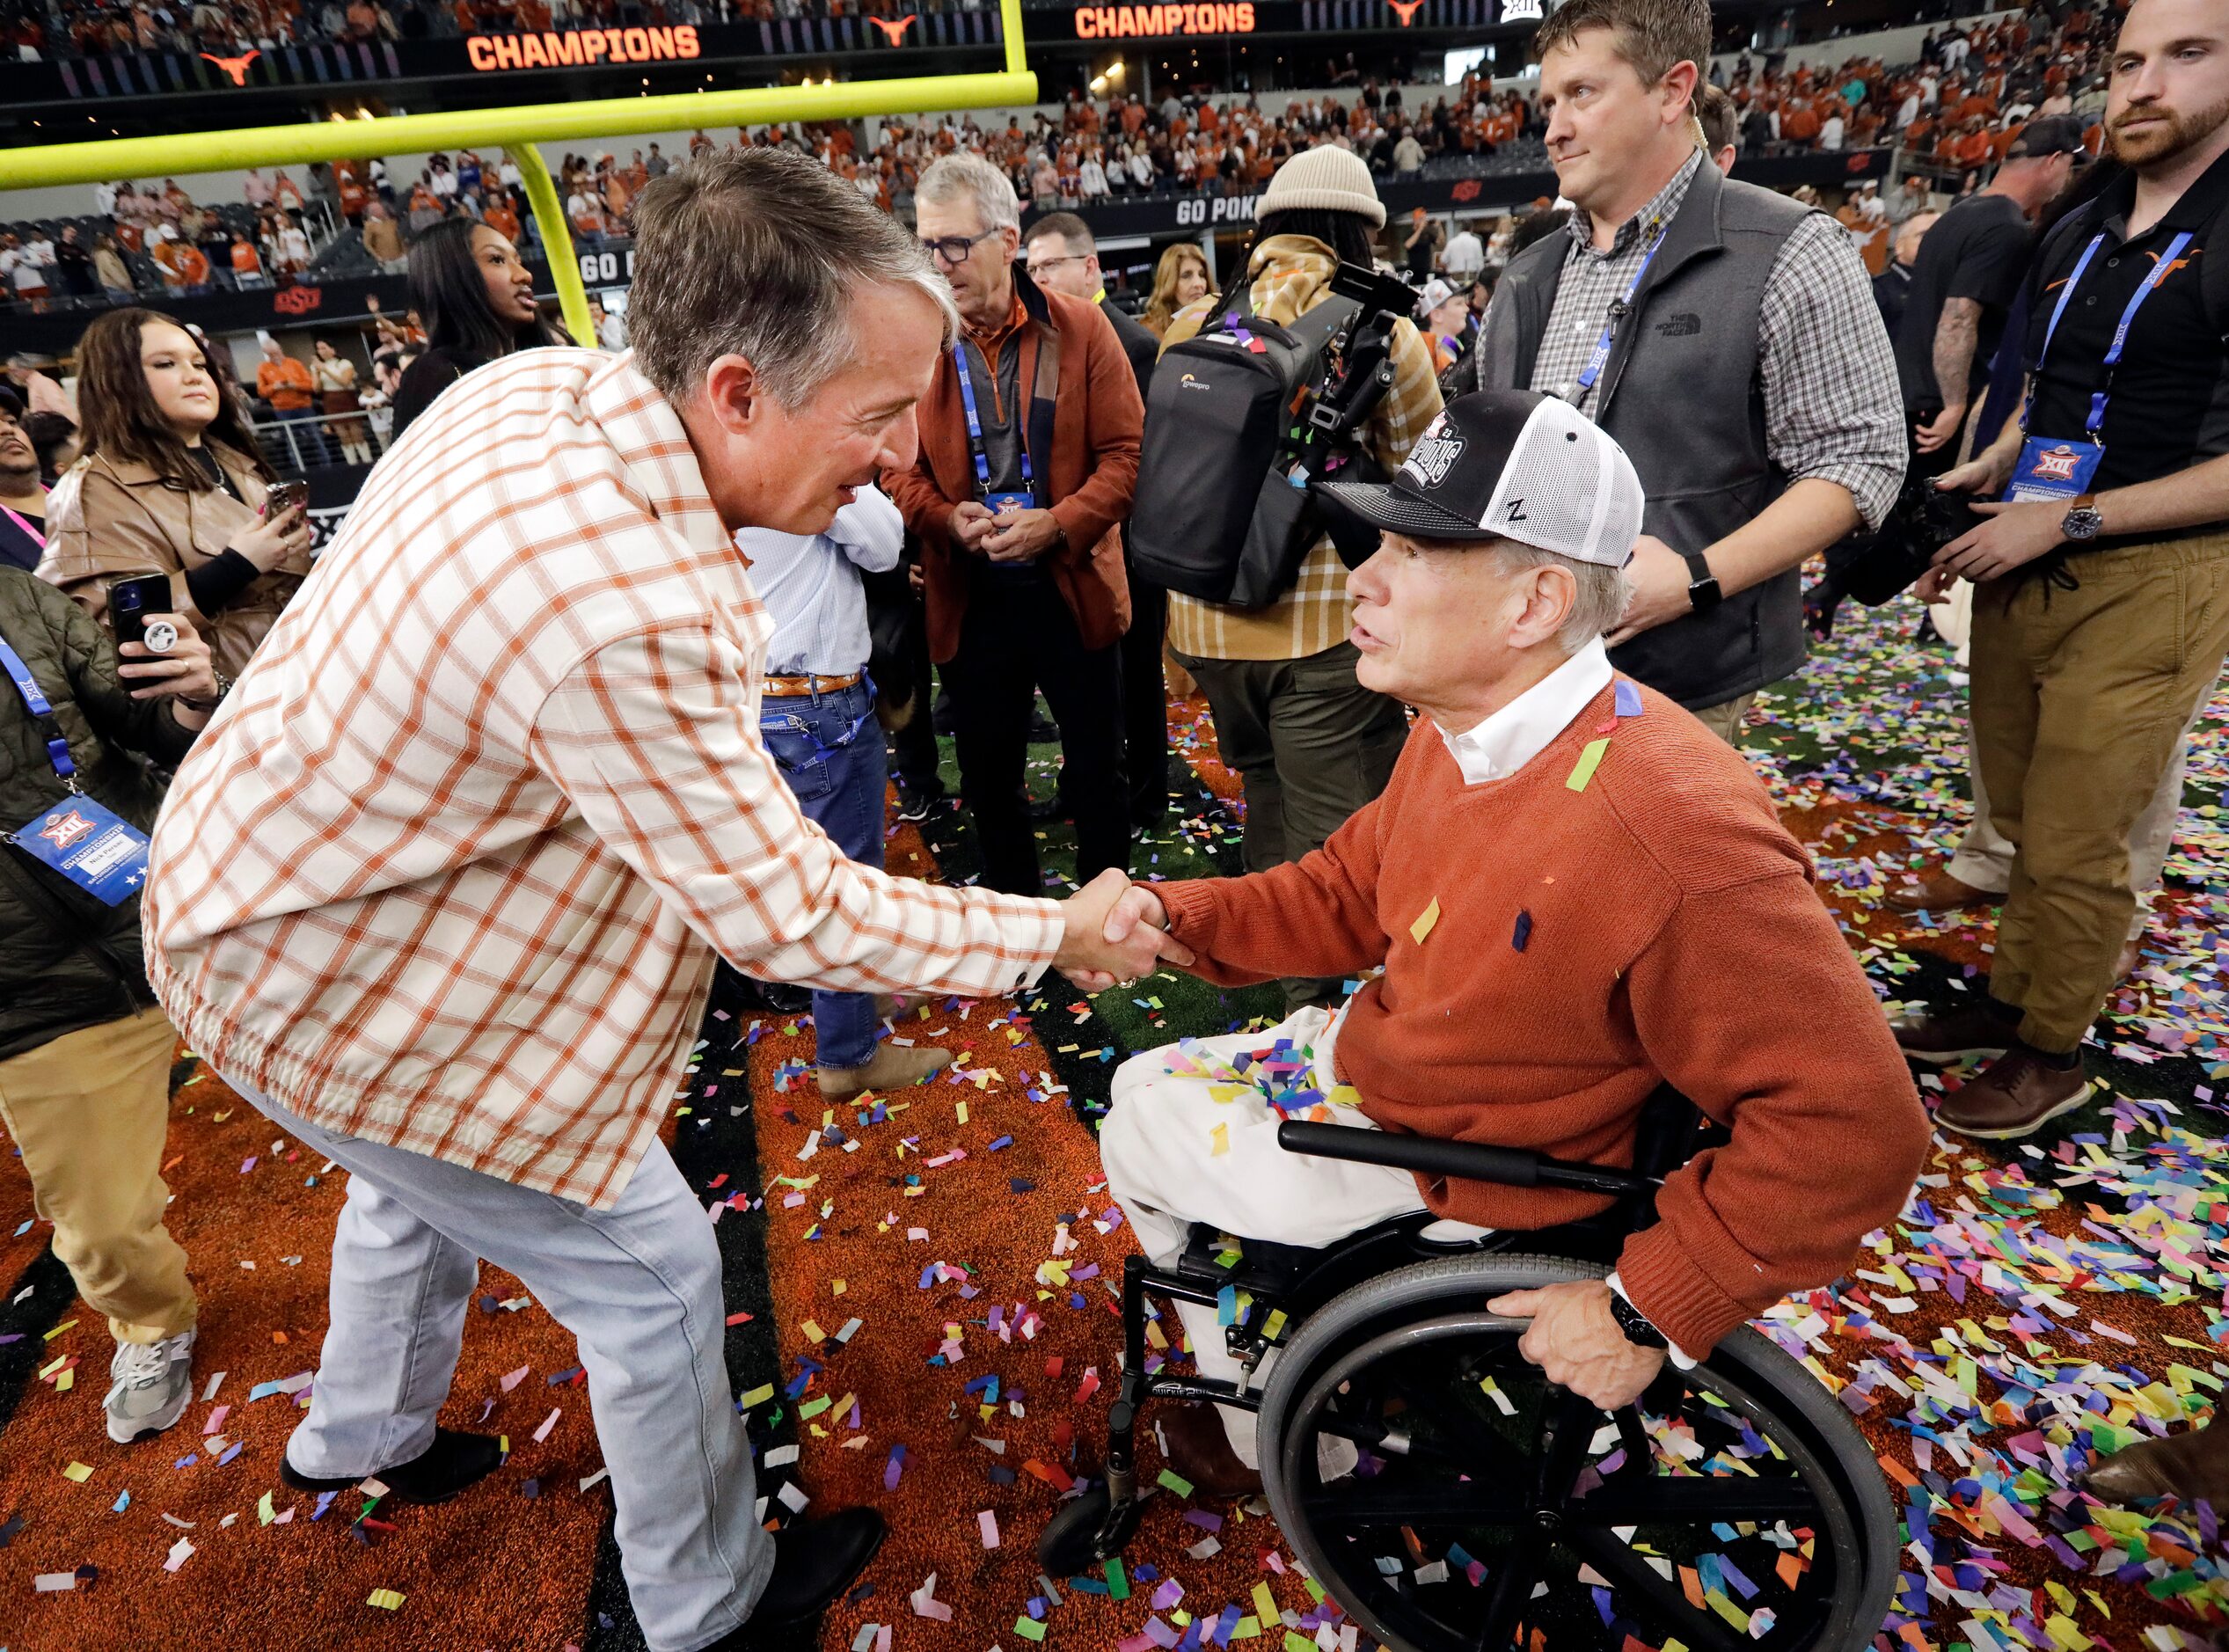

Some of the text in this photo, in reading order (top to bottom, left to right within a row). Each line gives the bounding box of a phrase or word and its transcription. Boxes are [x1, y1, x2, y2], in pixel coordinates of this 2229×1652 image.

[1075, 3, 1255, 39] CHAMPIONS
[466, 25, 701, 70] CHAMPIONS
[1177, 194, 1261, 224] GO POK
[580, 252, 618, 282] GO
[1182, 380, 1210, 391] Lowepro
[1442, 428, 1452, 438] 23
[2035, 455, 2074, 474] XII
[42, 814, 94, 847] XII
[63, 824, 125, 870] CHAMPIONSHIP
[89, 853, 104, 864] Nick
[1151, 1388, 1185, 1397] QUICKIE
